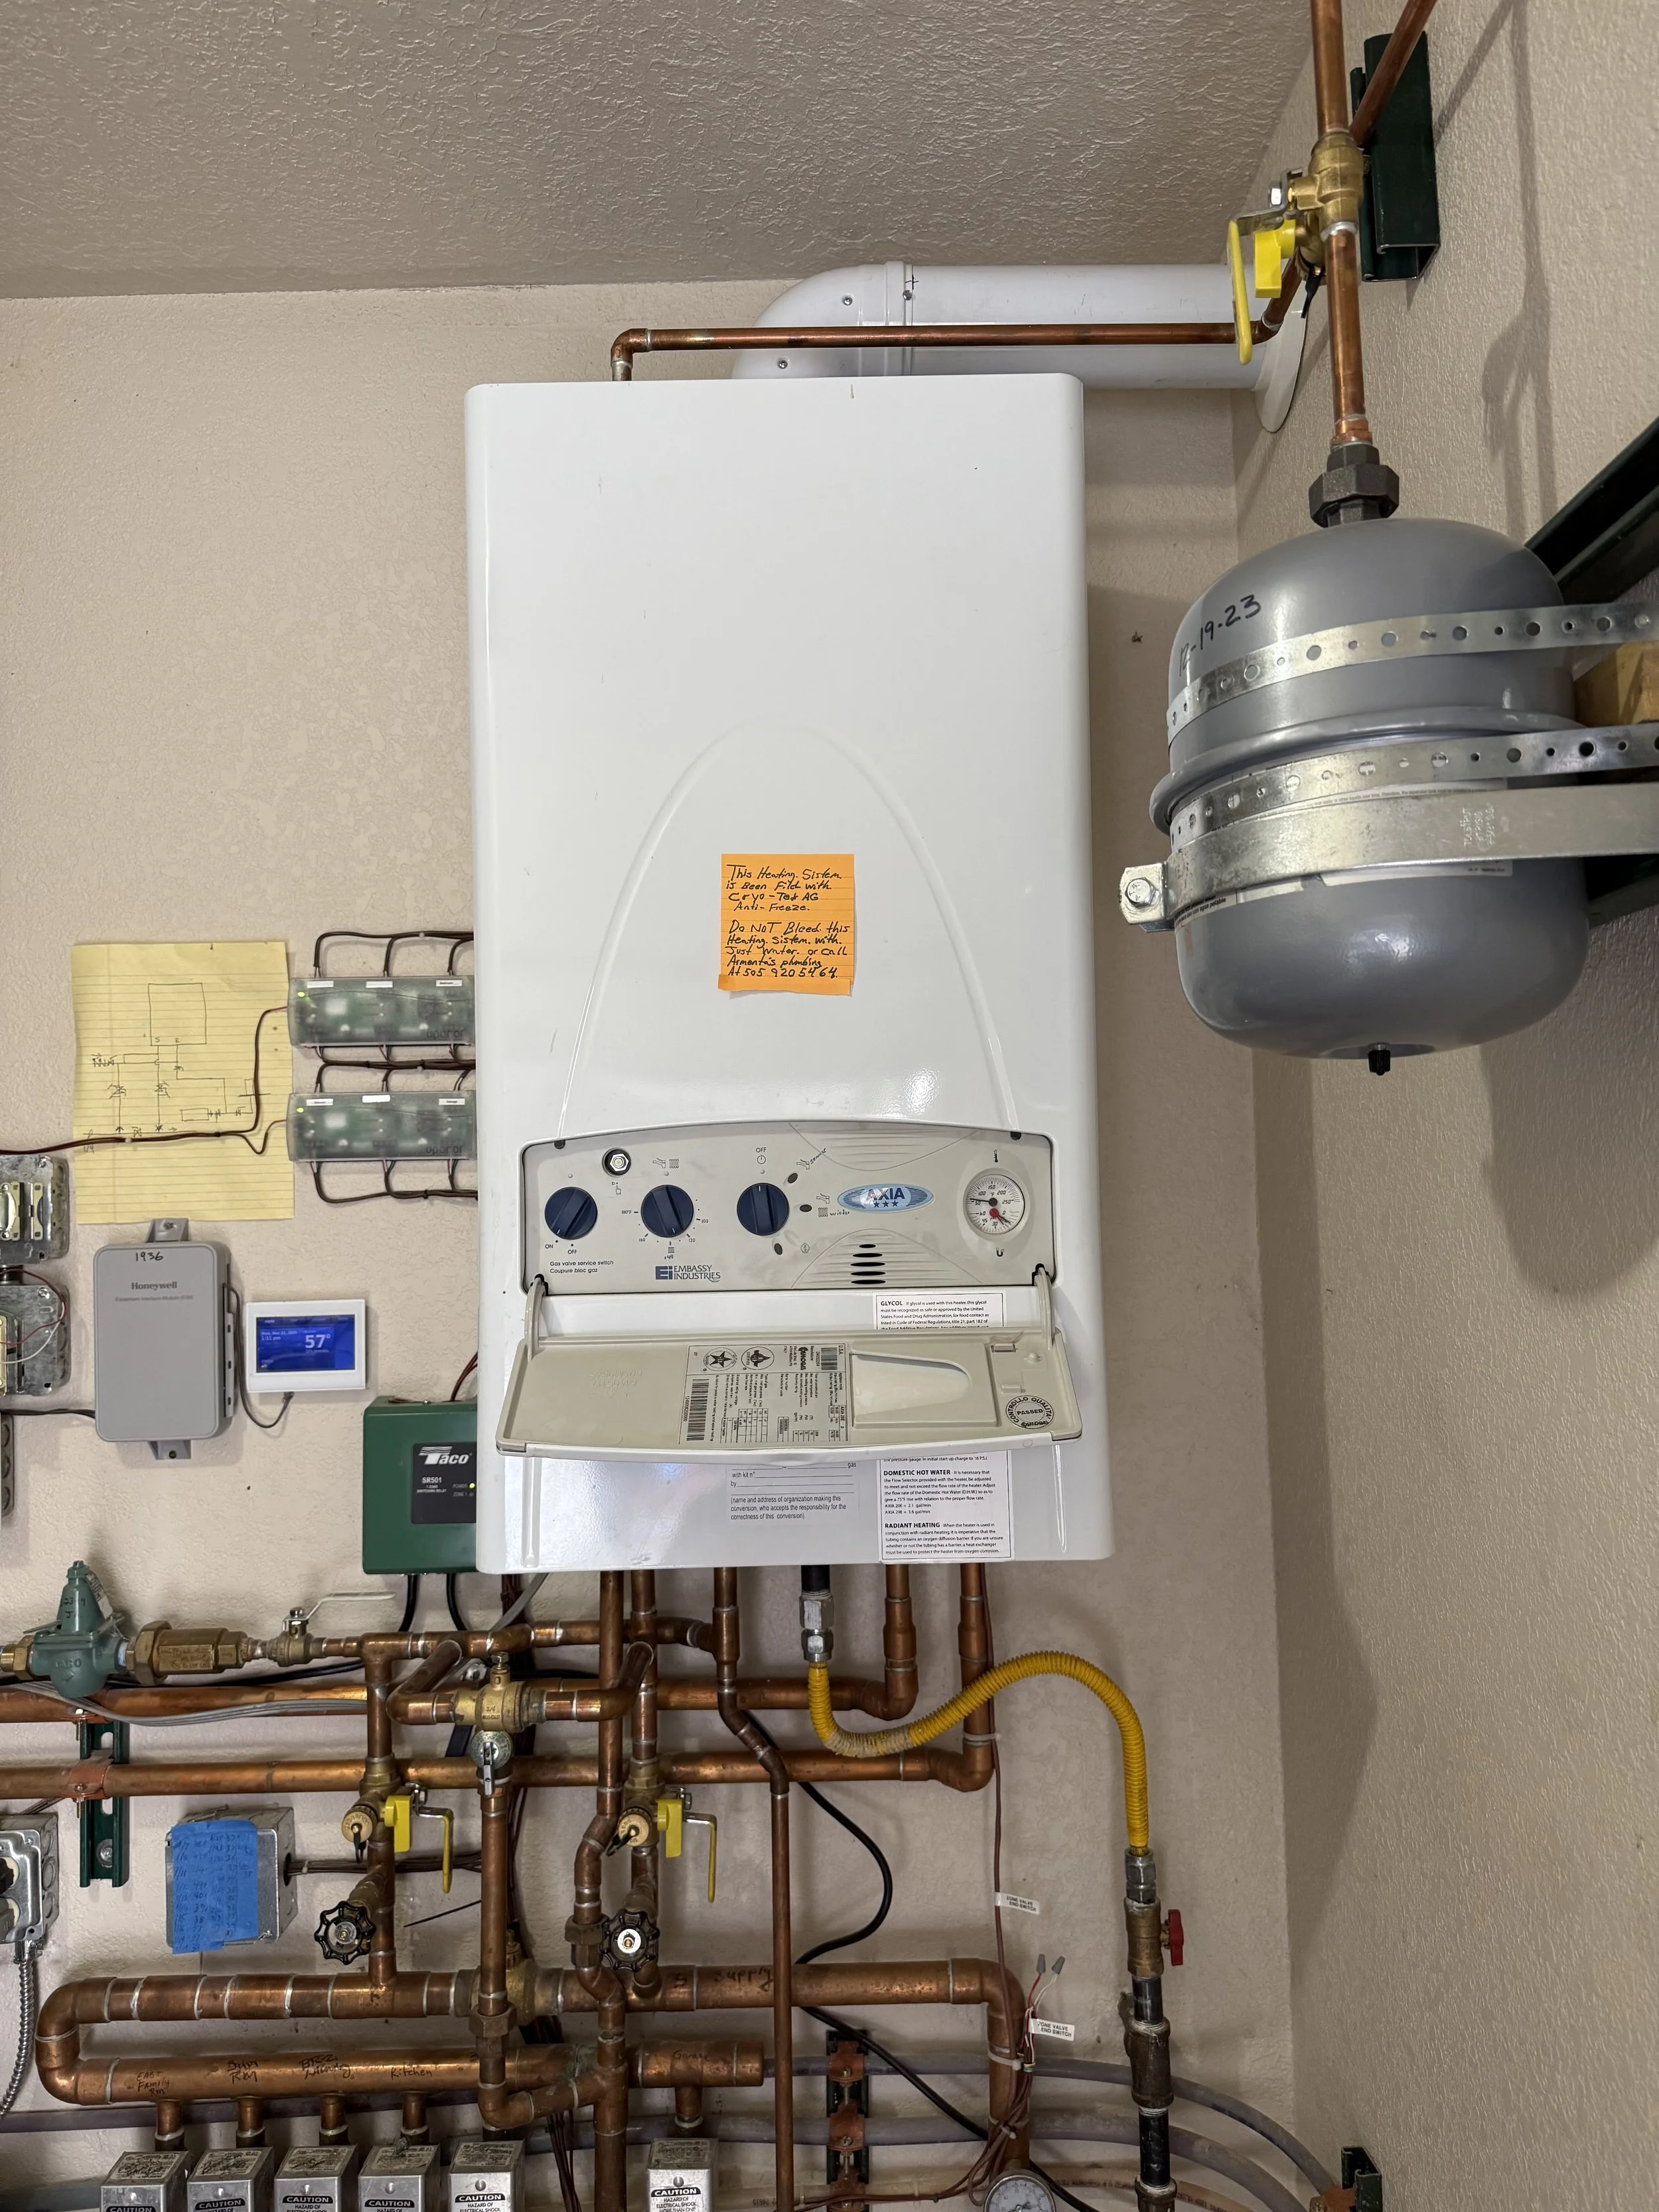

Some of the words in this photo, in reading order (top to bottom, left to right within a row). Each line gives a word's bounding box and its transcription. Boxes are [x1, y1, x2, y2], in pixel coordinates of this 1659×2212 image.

[727, 865, 752, 881] This
[729, 920, 745, 934] Do
[826, 921, 850, 933] this
[725, 944, 751, 954] Just
[867, 1188, 905, 1201] AXIA
[136, 1252, 163, 1262] 1936
[674, 1272, 721, 1282] INDUSTRIES
[131, 1282, 177, 1290] Honeywell
[1008, 1396, 1029, 1423] CONTROLLO
[419, 1446, 469, 1464] Taco
[784, 1497, 812, 1505] organization
[391, 2064, 433, 2080] Kitchen
[199, 2200, 242, 2209] CAUTION
